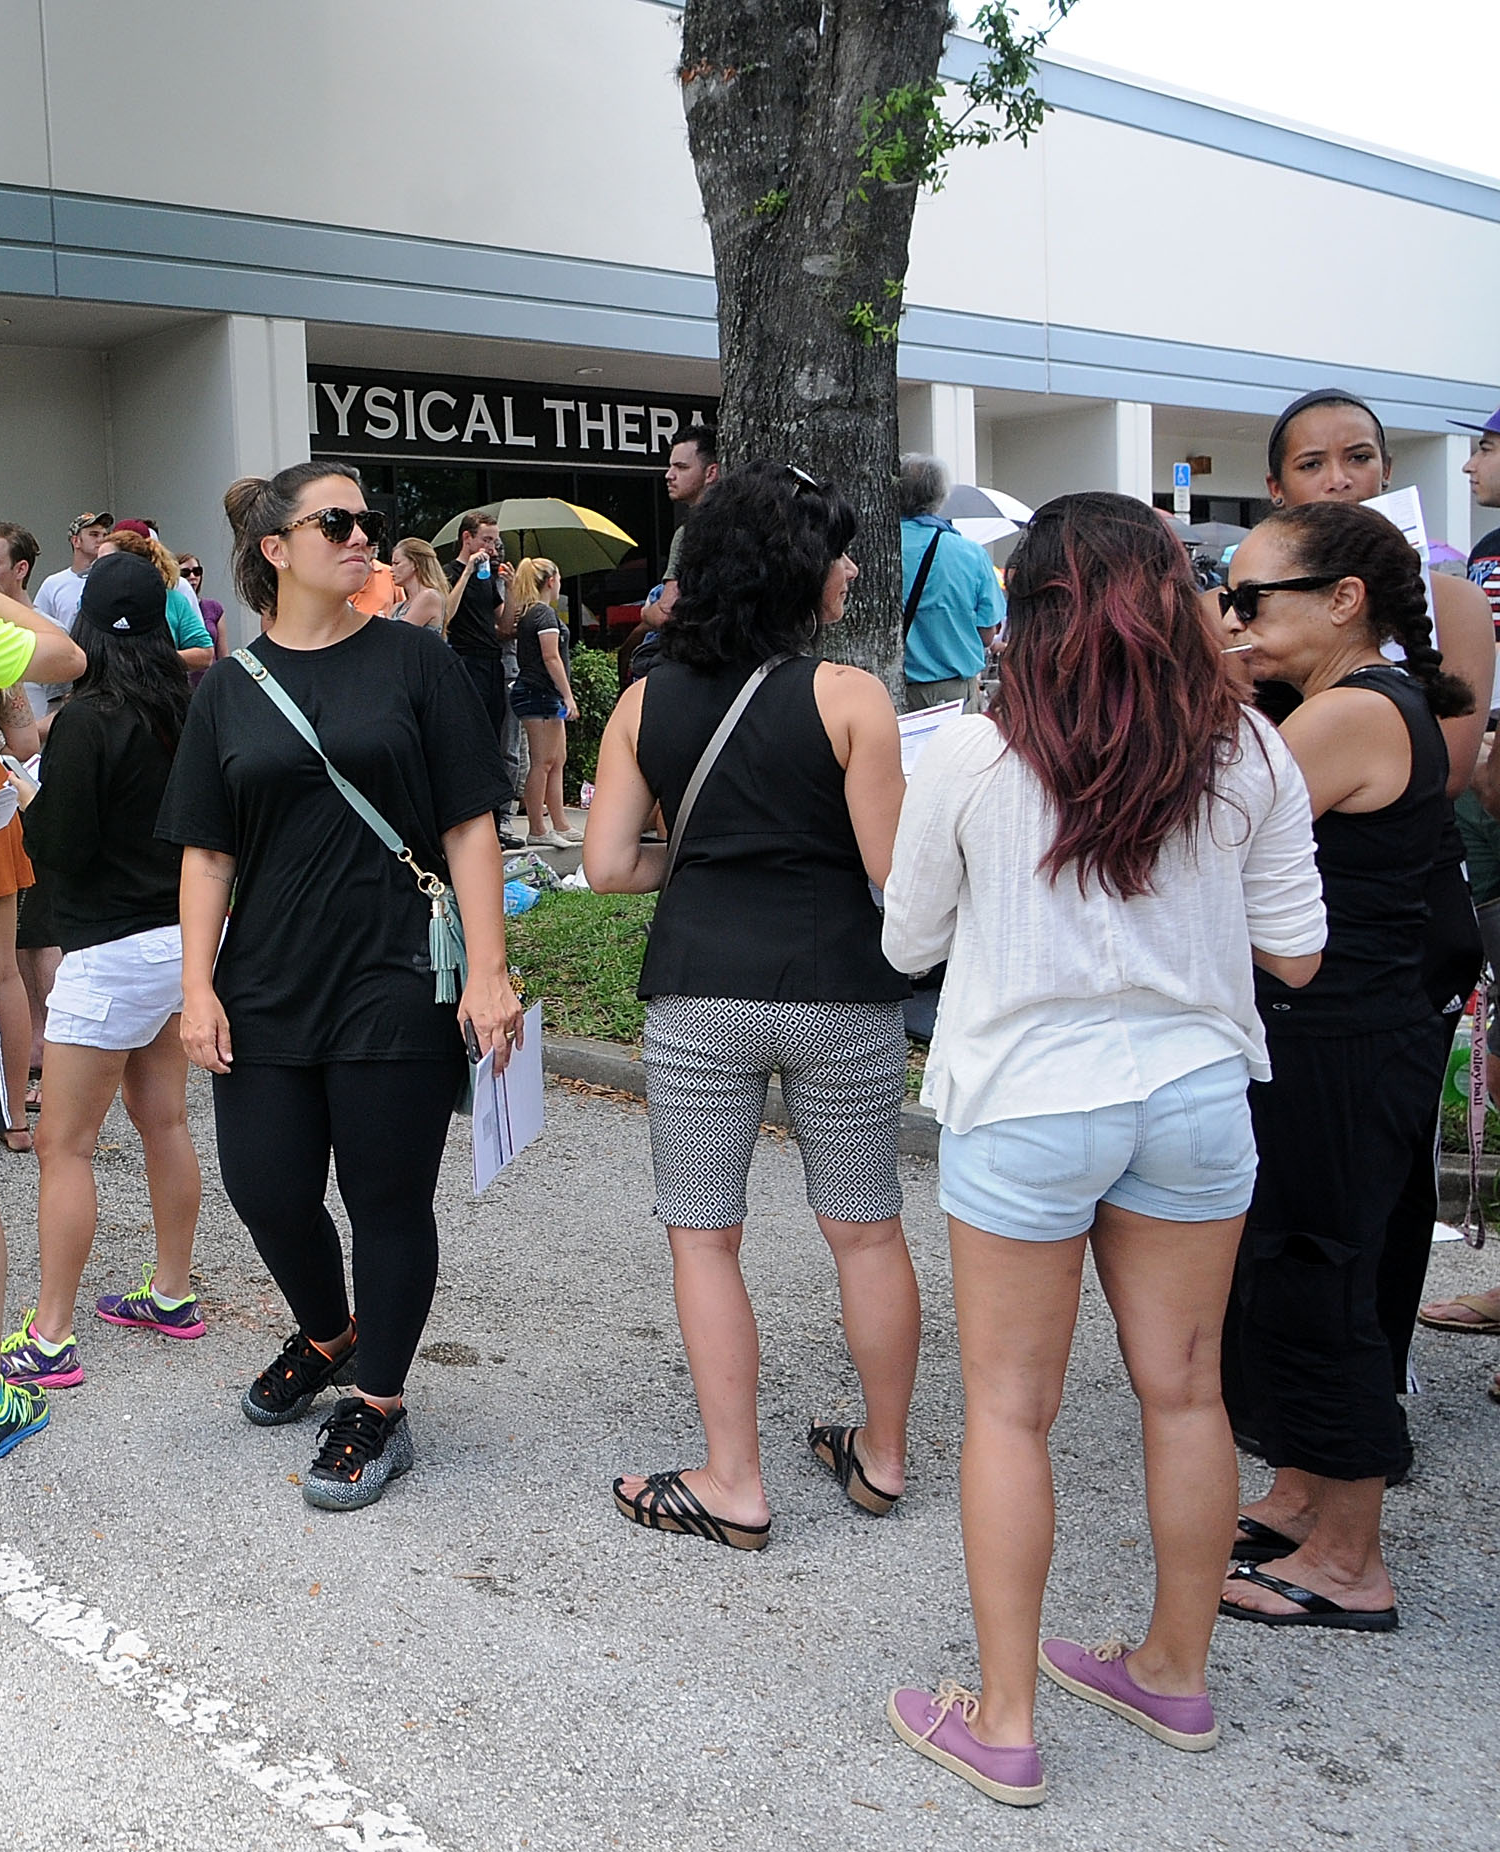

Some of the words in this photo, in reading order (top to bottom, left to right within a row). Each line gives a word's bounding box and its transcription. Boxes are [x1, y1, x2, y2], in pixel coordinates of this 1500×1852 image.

[306, 382, 536, 448] YSICAL
[543, 397, 705, 455] THER
[1475, 1001, 1483, 1032] Love
[1471, 1037, 1483, 1106] Volleyball
